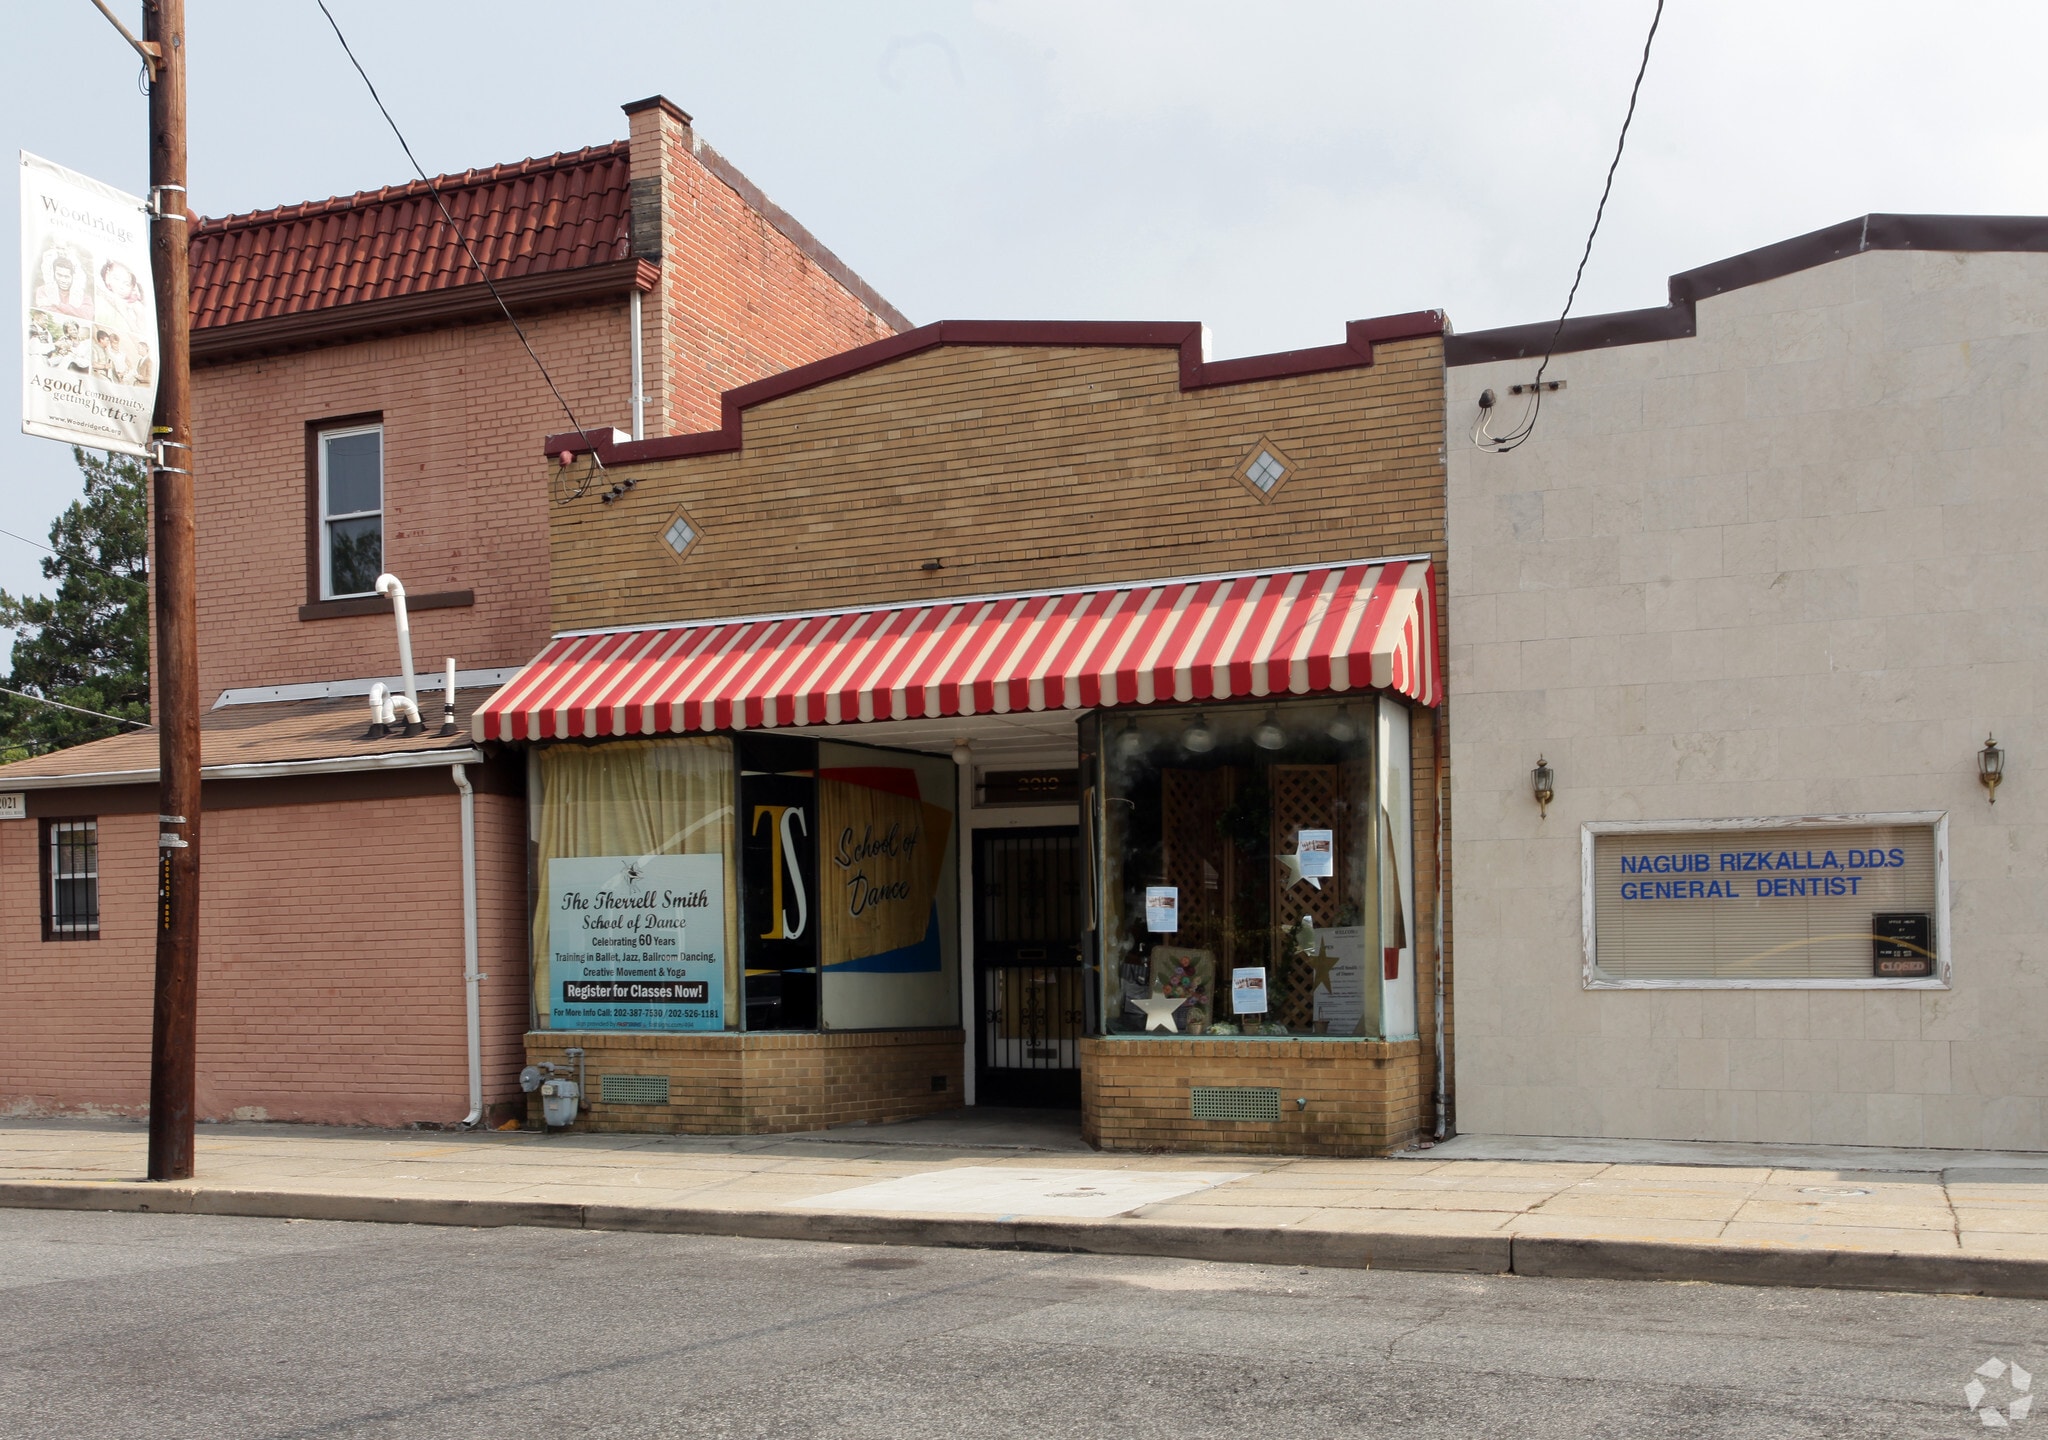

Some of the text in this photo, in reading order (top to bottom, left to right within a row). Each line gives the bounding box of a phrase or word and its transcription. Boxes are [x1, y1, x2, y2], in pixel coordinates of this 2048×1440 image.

[40, 195, 135, 243] Woodridge
[31, 374, 145, 412] A good community,
[53, 391, 137, 424] getting better.
[49, 415, 122, 436] www.WoodridgeCA.org
[834, 823, 921, 870] School of
[1621, 854, 1710, 874] NAGUIB
[847, 869, 911, 918] Dance
[1621, 877, 1862, 900] GENERAL DENTIST
[561, 889, 709, 910] The Therrell Smith
[582, 913, 687, 933] School of Dance
[592, 934, 676, 948] Celebrating 60 Years
[555, 952, 716, 963] Training in Ballet, Jazz, Ballroom Dancing,
[1881, 961, 1925, 971] CLOSED
[583, 967, 686, 978] Creative Movement & Yoga
[568, 984, 703, 999] Register for Classes Now!
[554, 1008, 564, 1017] For
[565, 1008, 582, 1017] More
[583, 1008, 596, 1017] Info
[597, 1008, 612, 1017] Call:
